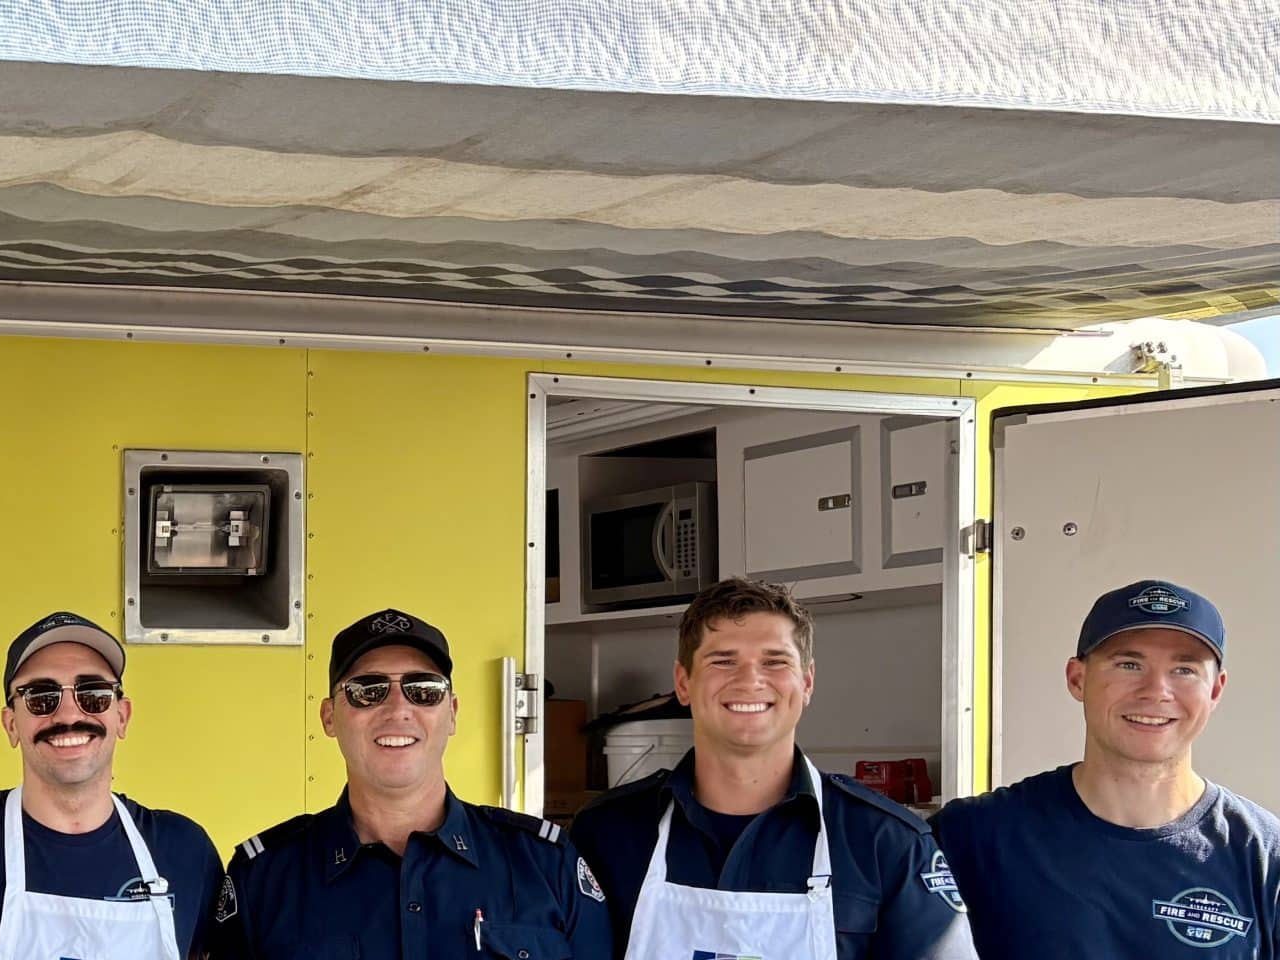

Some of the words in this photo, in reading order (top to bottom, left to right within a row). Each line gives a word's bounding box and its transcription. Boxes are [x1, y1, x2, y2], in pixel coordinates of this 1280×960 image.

[1160, 905, 1186, 918] FIRE
[1187, 911, 1201, 919] AND
[1201, 912, 1244, 930] RESCUE
